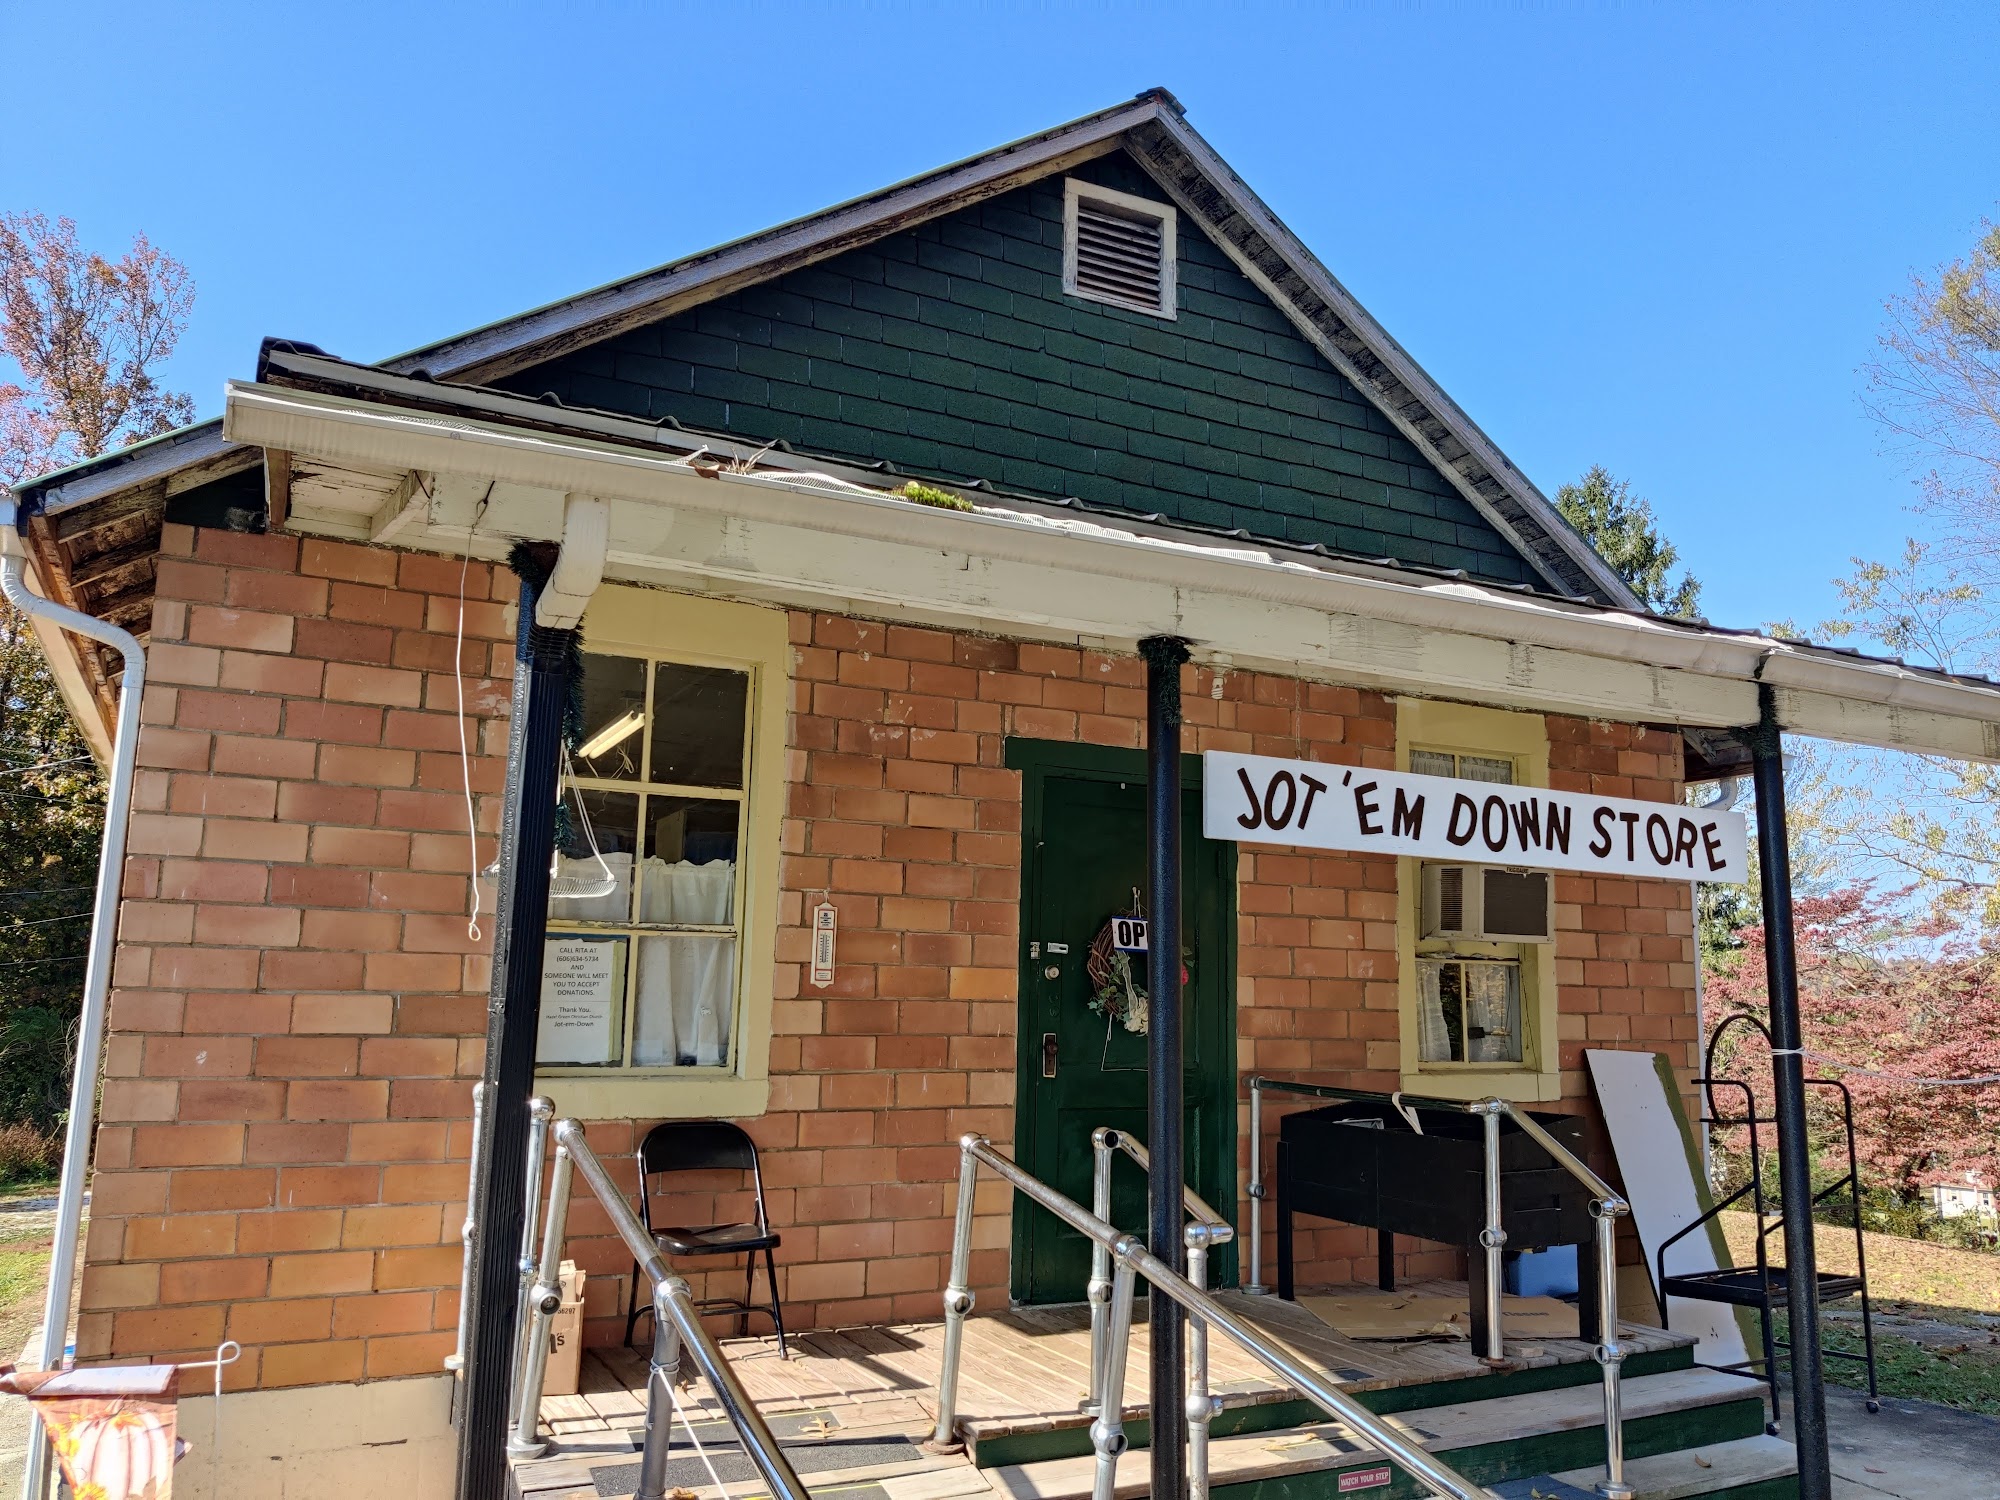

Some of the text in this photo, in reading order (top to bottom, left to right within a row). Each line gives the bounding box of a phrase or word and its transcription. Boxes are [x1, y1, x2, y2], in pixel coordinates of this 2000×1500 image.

[1237, 768, 1727, 872] JOT 'EM DOWN STORE
[1117, 920, 1148, 948] OP
[1341, 1471, 1389, 1487] WATCH YOUR STEP
